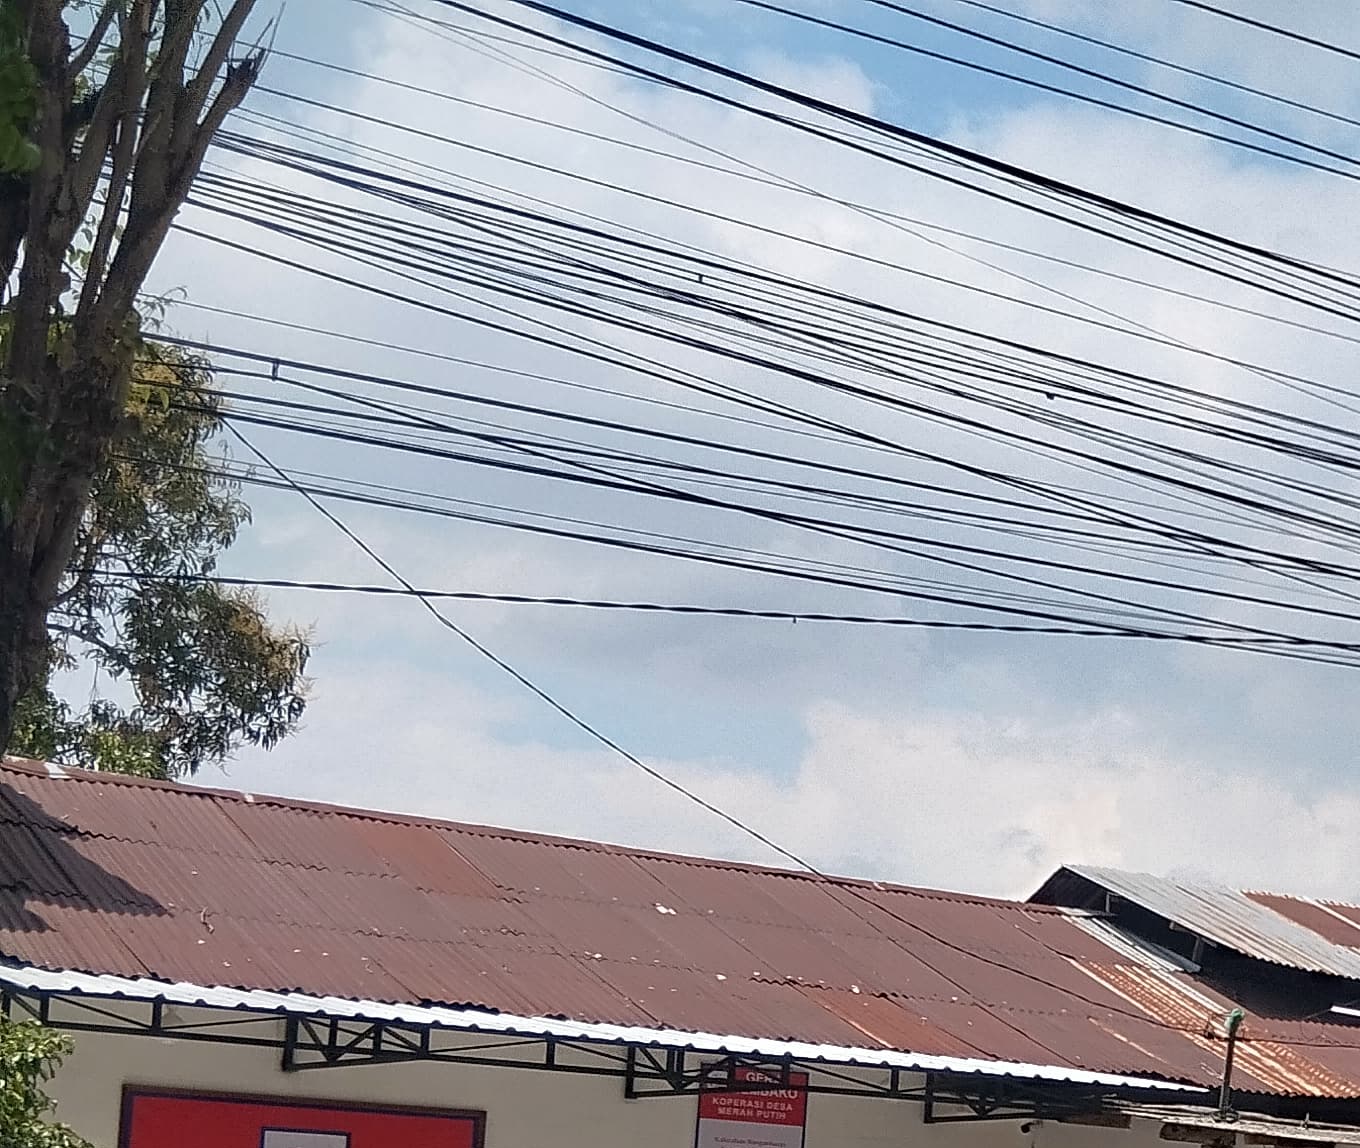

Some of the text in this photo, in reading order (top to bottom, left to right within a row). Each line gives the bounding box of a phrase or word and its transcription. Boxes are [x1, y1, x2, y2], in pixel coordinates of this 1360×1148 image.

[713, 1097, 793, 1111] KOPERASI DESA
[717, 1107, 786, 1120] MERAH PUTIH
